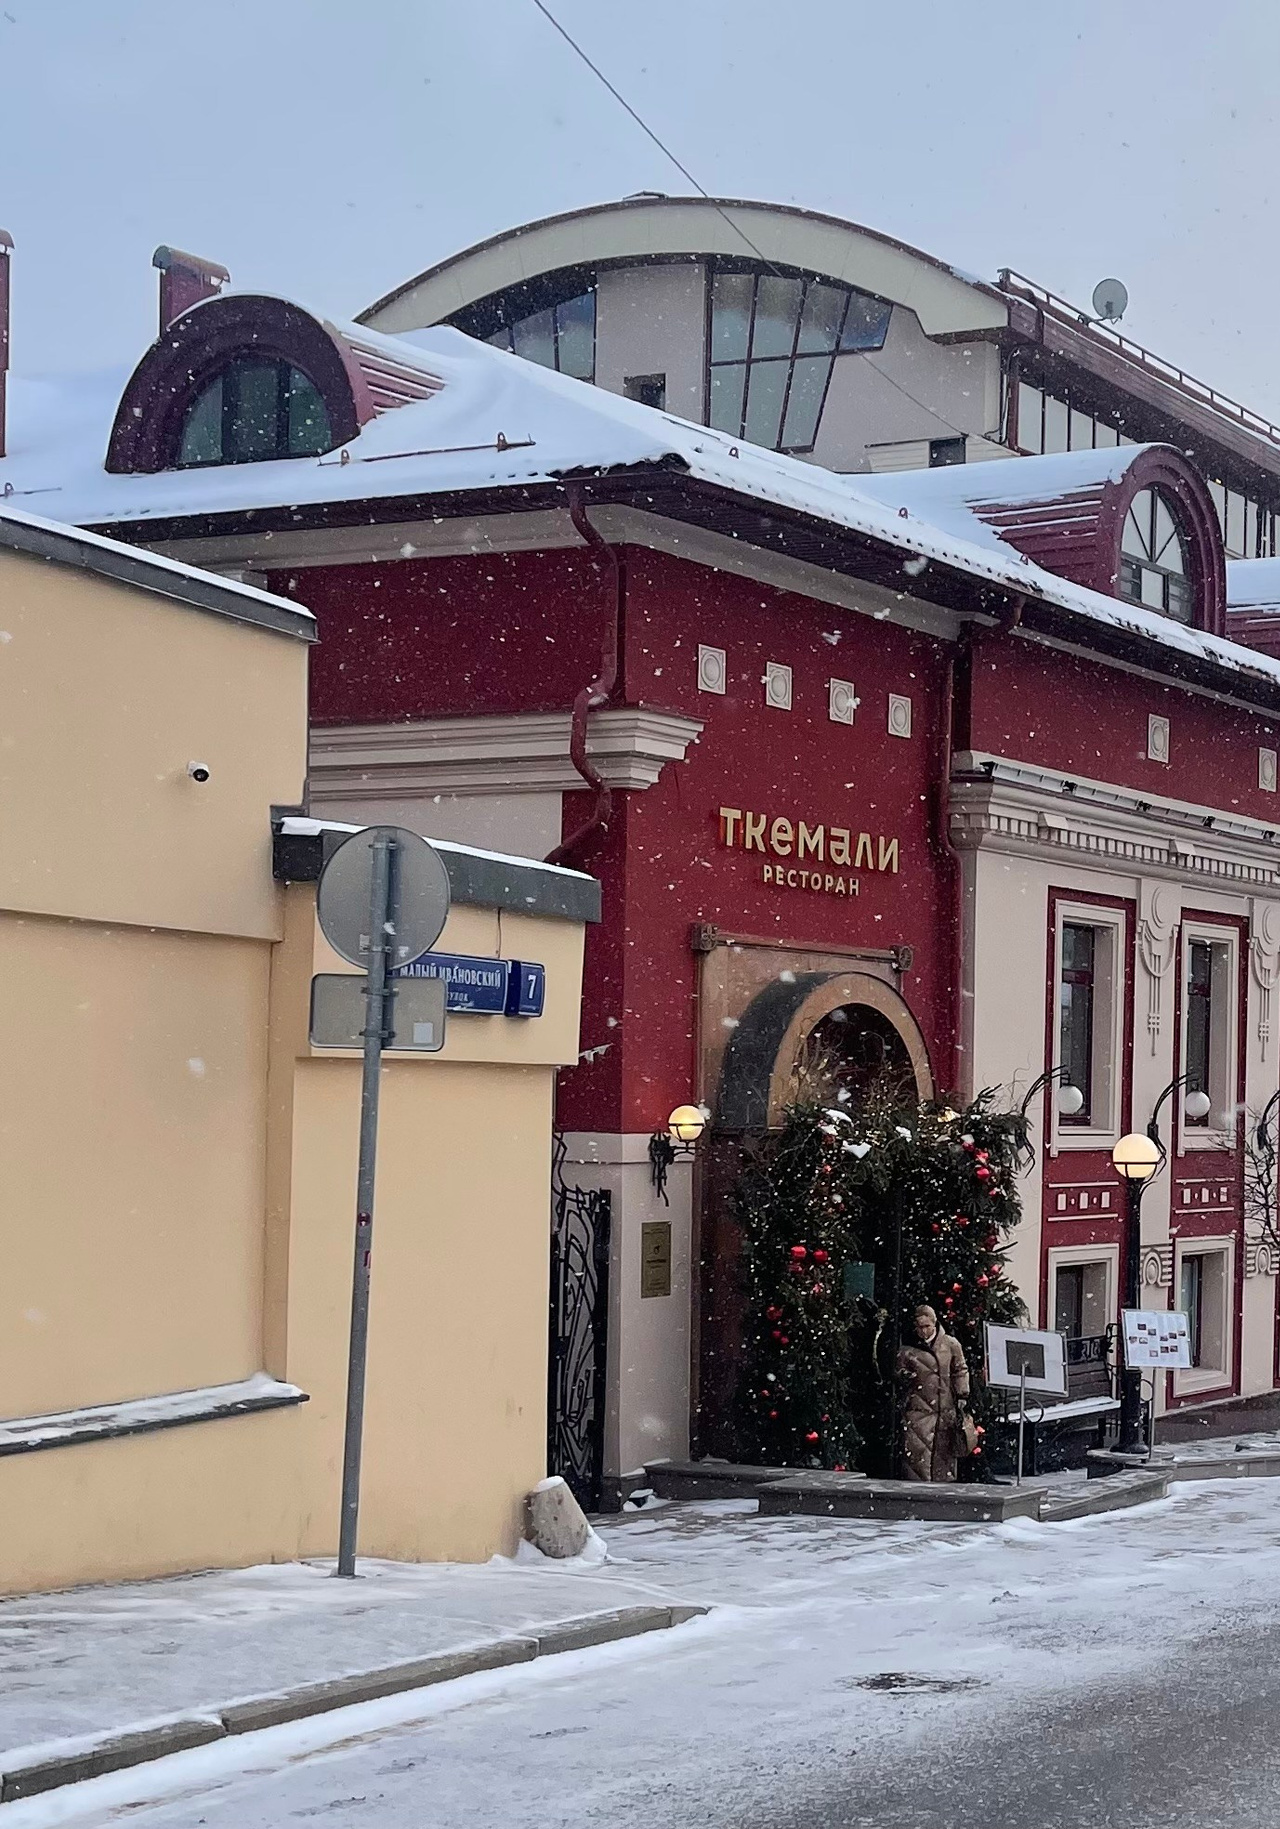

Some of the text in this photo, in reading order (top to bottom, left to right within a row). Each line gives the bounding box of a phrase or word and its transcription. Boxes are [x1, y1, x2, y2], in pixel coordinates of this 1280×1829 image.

[763, 865, 860, 896] РЕСТОРАН
[400, 962, 437, 978] МАЛЫЙ
[527, 974, 537, 999] 7
